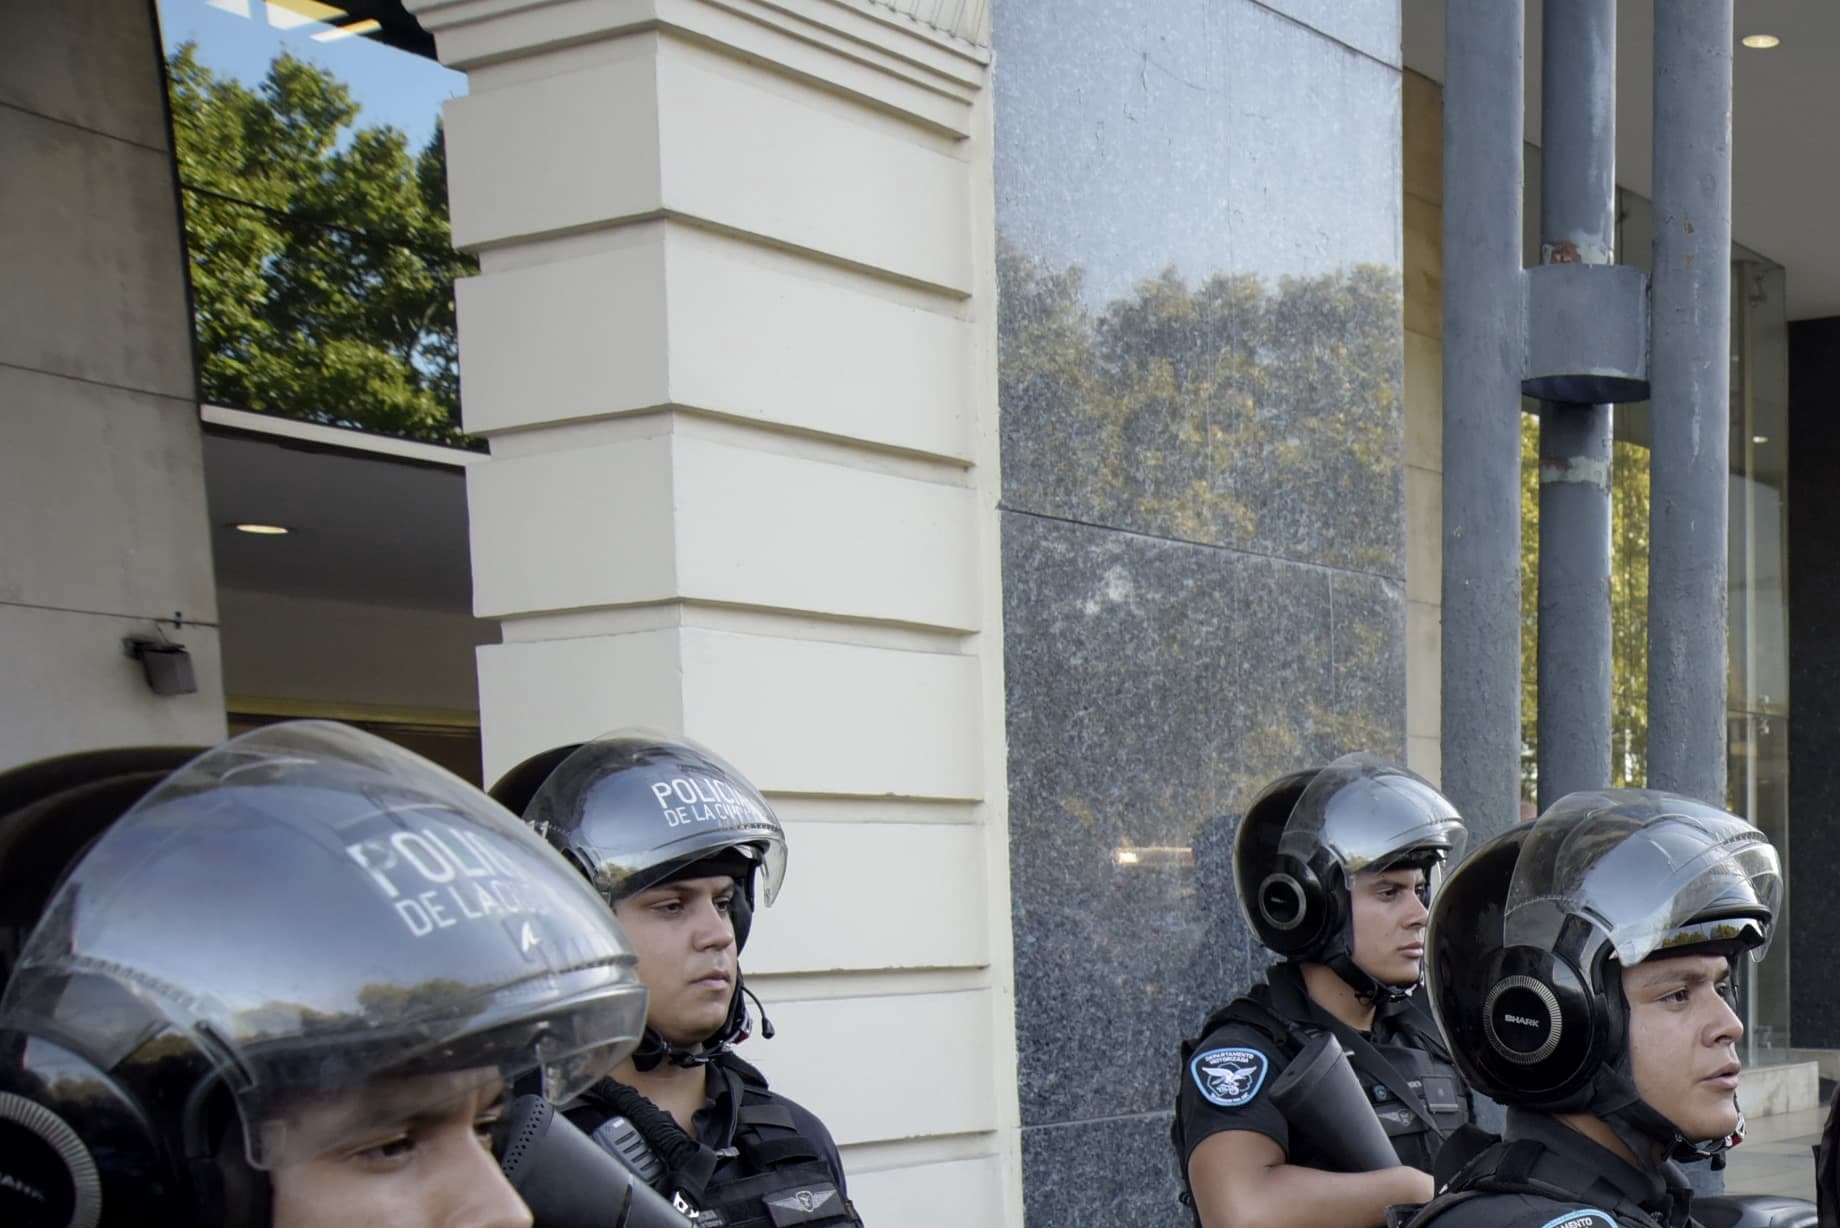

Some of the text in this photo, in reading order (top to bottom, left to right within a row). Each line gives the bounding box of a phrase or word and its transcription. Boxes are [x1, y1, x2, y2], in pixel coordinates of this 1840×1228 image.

[664, 806, 691, 827] DE
[691, 803, 716, 821] LA
[395, 891, 457, 937] DE
[448, 881, 500, 919] LA
[1504, 1014, 1540, 1028] SHARK
